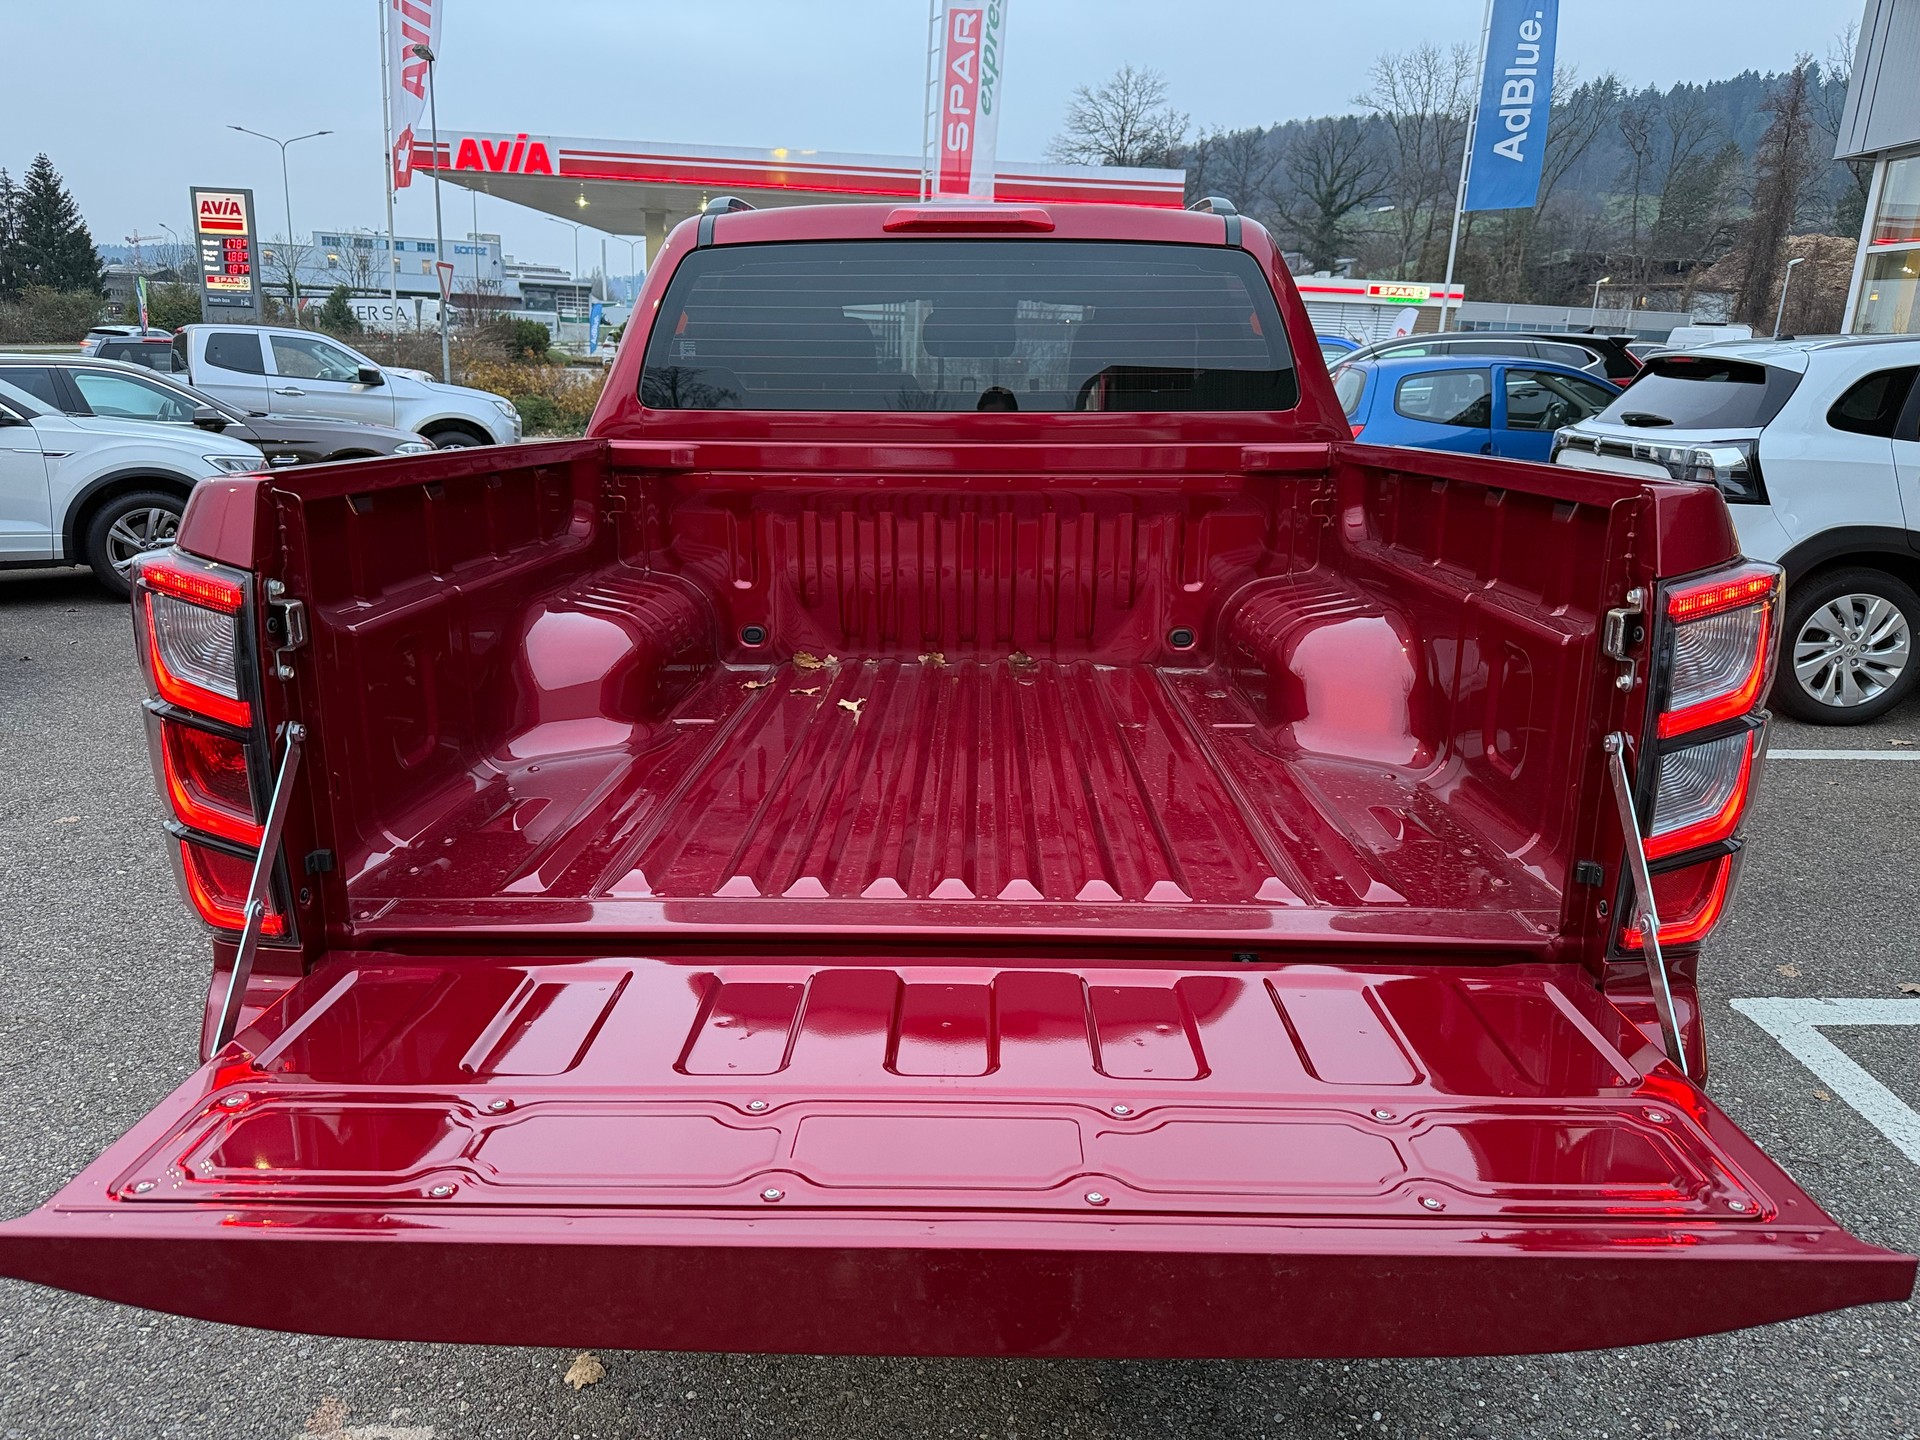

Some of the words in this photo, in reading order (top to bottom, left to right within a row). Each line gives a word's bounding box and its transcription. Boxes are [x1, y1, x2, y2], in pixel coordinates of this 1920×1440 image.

[392, 0, 432, 101] AVI
[946, 12, 978, 152] SPAR
[213, 276, 240, 284] SPAR
[1379, 286, 1415, 297] SPAR
